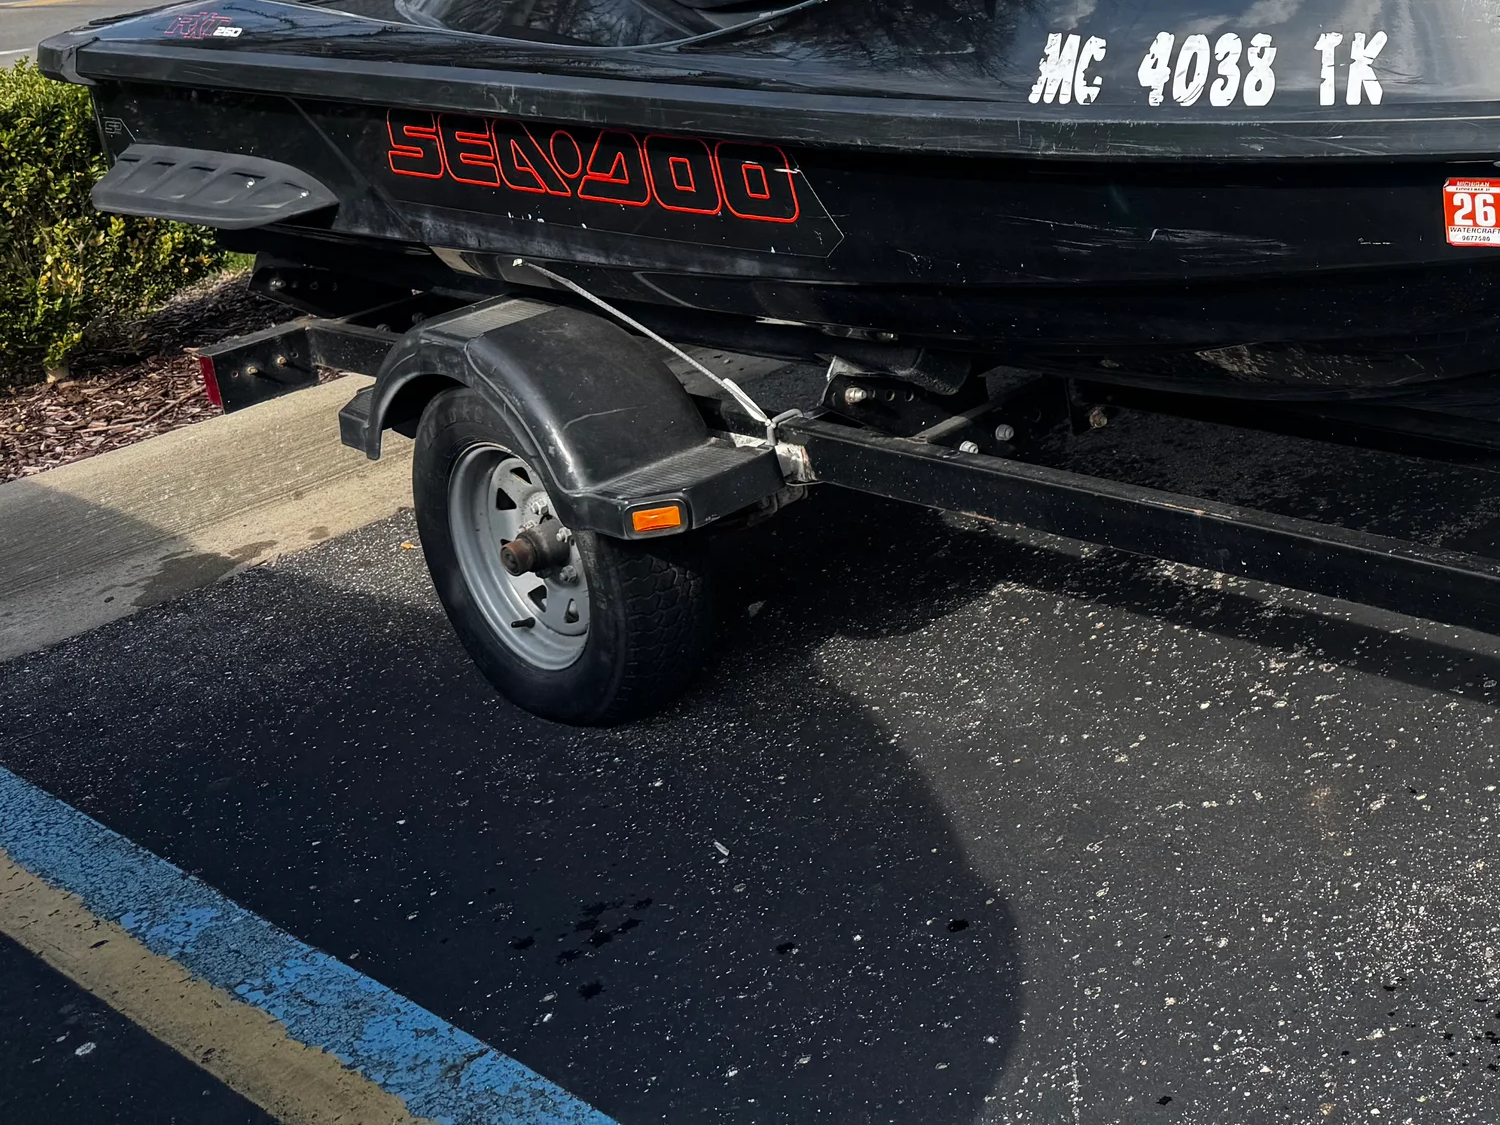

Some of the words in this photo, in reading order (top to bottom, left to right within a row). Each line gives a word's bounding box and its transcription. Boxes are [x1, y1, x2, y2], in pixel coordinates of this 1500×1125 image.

[213, 26, 243, 39] 260
[1027, 32, 1107, 106] MC
[1137, 31, 1278, 107] 4038
[1314, 30, 1389, 106] TK
[1452, 193, 1496, 227] 26
